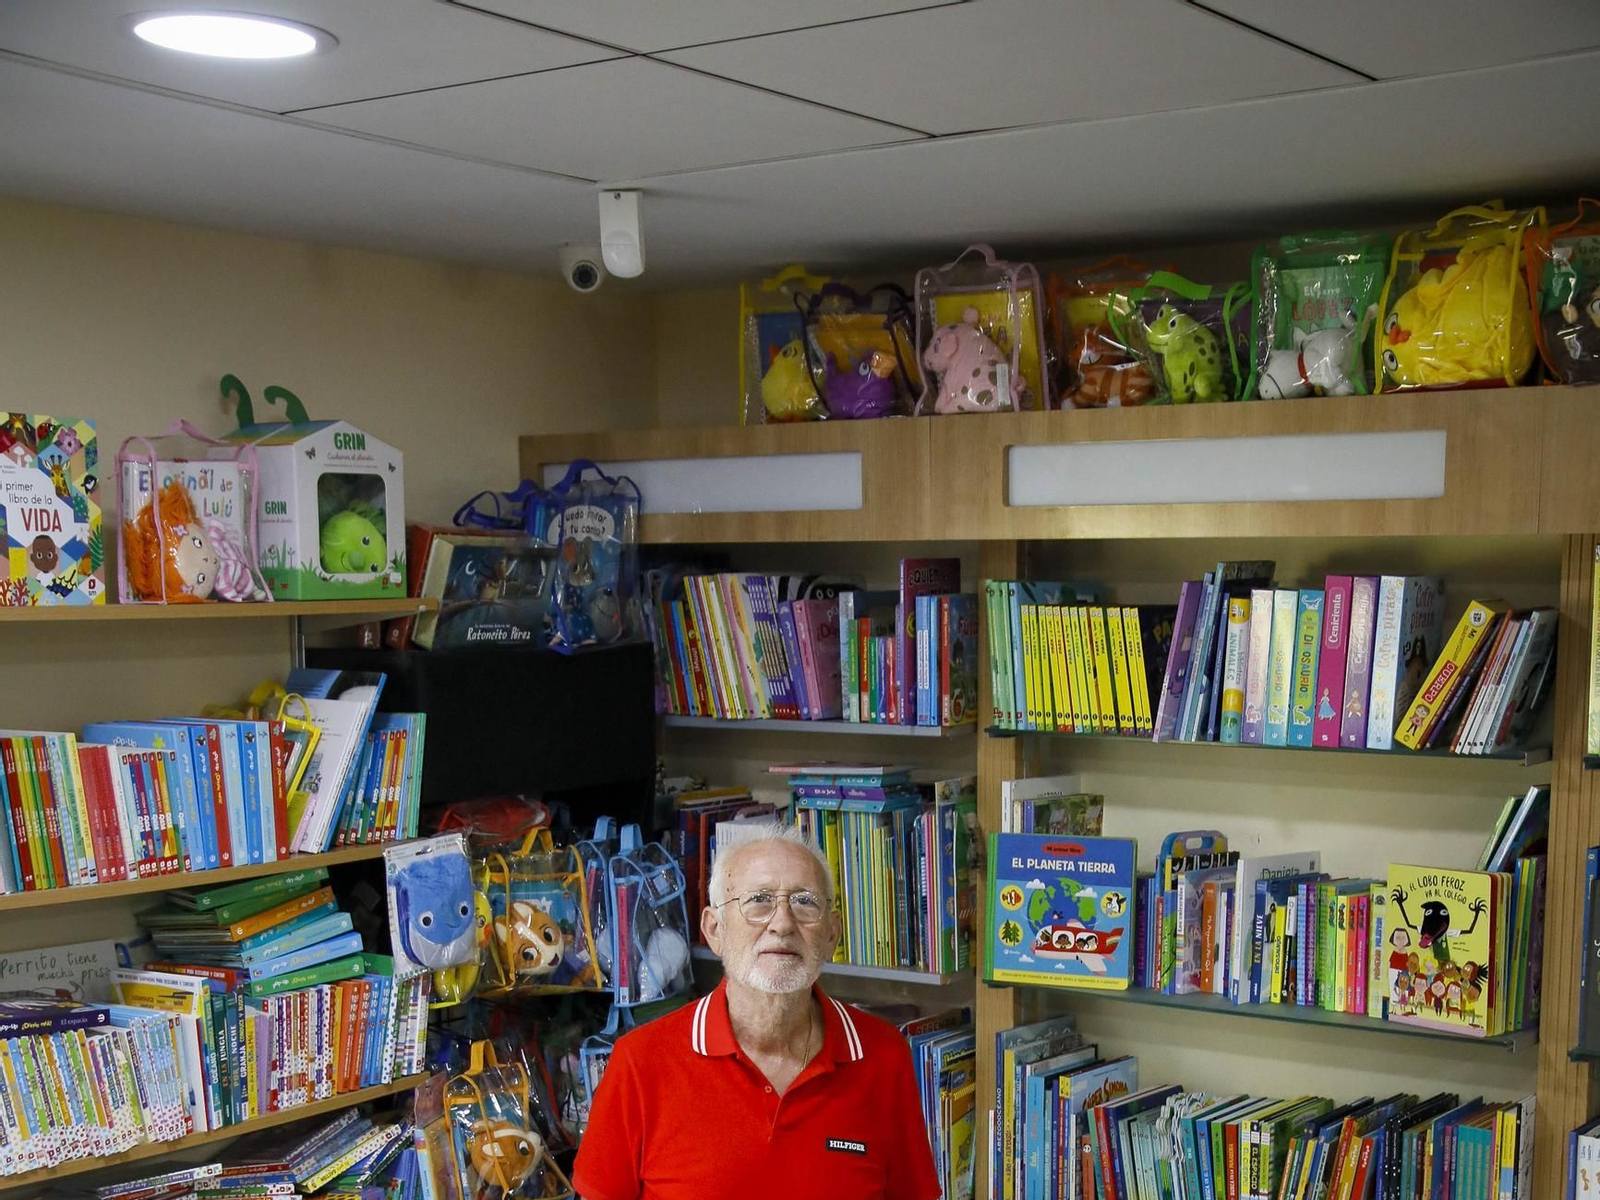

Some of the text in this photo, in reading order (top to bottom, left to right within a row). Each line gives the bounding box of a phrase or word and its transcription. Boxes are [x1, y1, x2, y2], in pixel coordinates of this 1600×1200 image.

[333, 432, 366, 450] GRIN
[6, 482, 33, 491] primer
[220, 478, 233, 492] de
[9, 494, 52, 504] libro de la
[203, 497, 233, 518] Lulú
[265, 501, 287, 515] GRIN
[21, 508, 62, 532] VIDA
[1328, 592, 1342, 643] Cenicienta
[467, 626, 531, 641] Ratoncito Pérez
[1378, 589, 1397, 668] Cofre pirata
[1227, 632, 1237, 681] ANIMALES
[1424, 663, 1457, 702] CUERPO
[1012, 857, 1116, 874] EL PLANETA TIERRA
[1409, 875, 1466, 893] EL LOBO FEROZ
[1424, 889, 1467, 905] VA AL COLEGIO
[1256, 914, 1264, 939] NIEVE
[1, 951, 98, 979] Perrito tiene
[37, 966, 110, 984] mucha prisa
[68, 1017, 88, 1025] espacio
[218, 1029, 228, 1061] JUNGLA
[230, 1025, 238, 1055] NOCHE
[209, 1052, 219, 1084] OCÉANO
[240, 1045, 248, 1078] GRANJA
[829, 1140, 865, 1152] HILFIGER
[1250, 1157, 1258, 1189] ESPACIO
